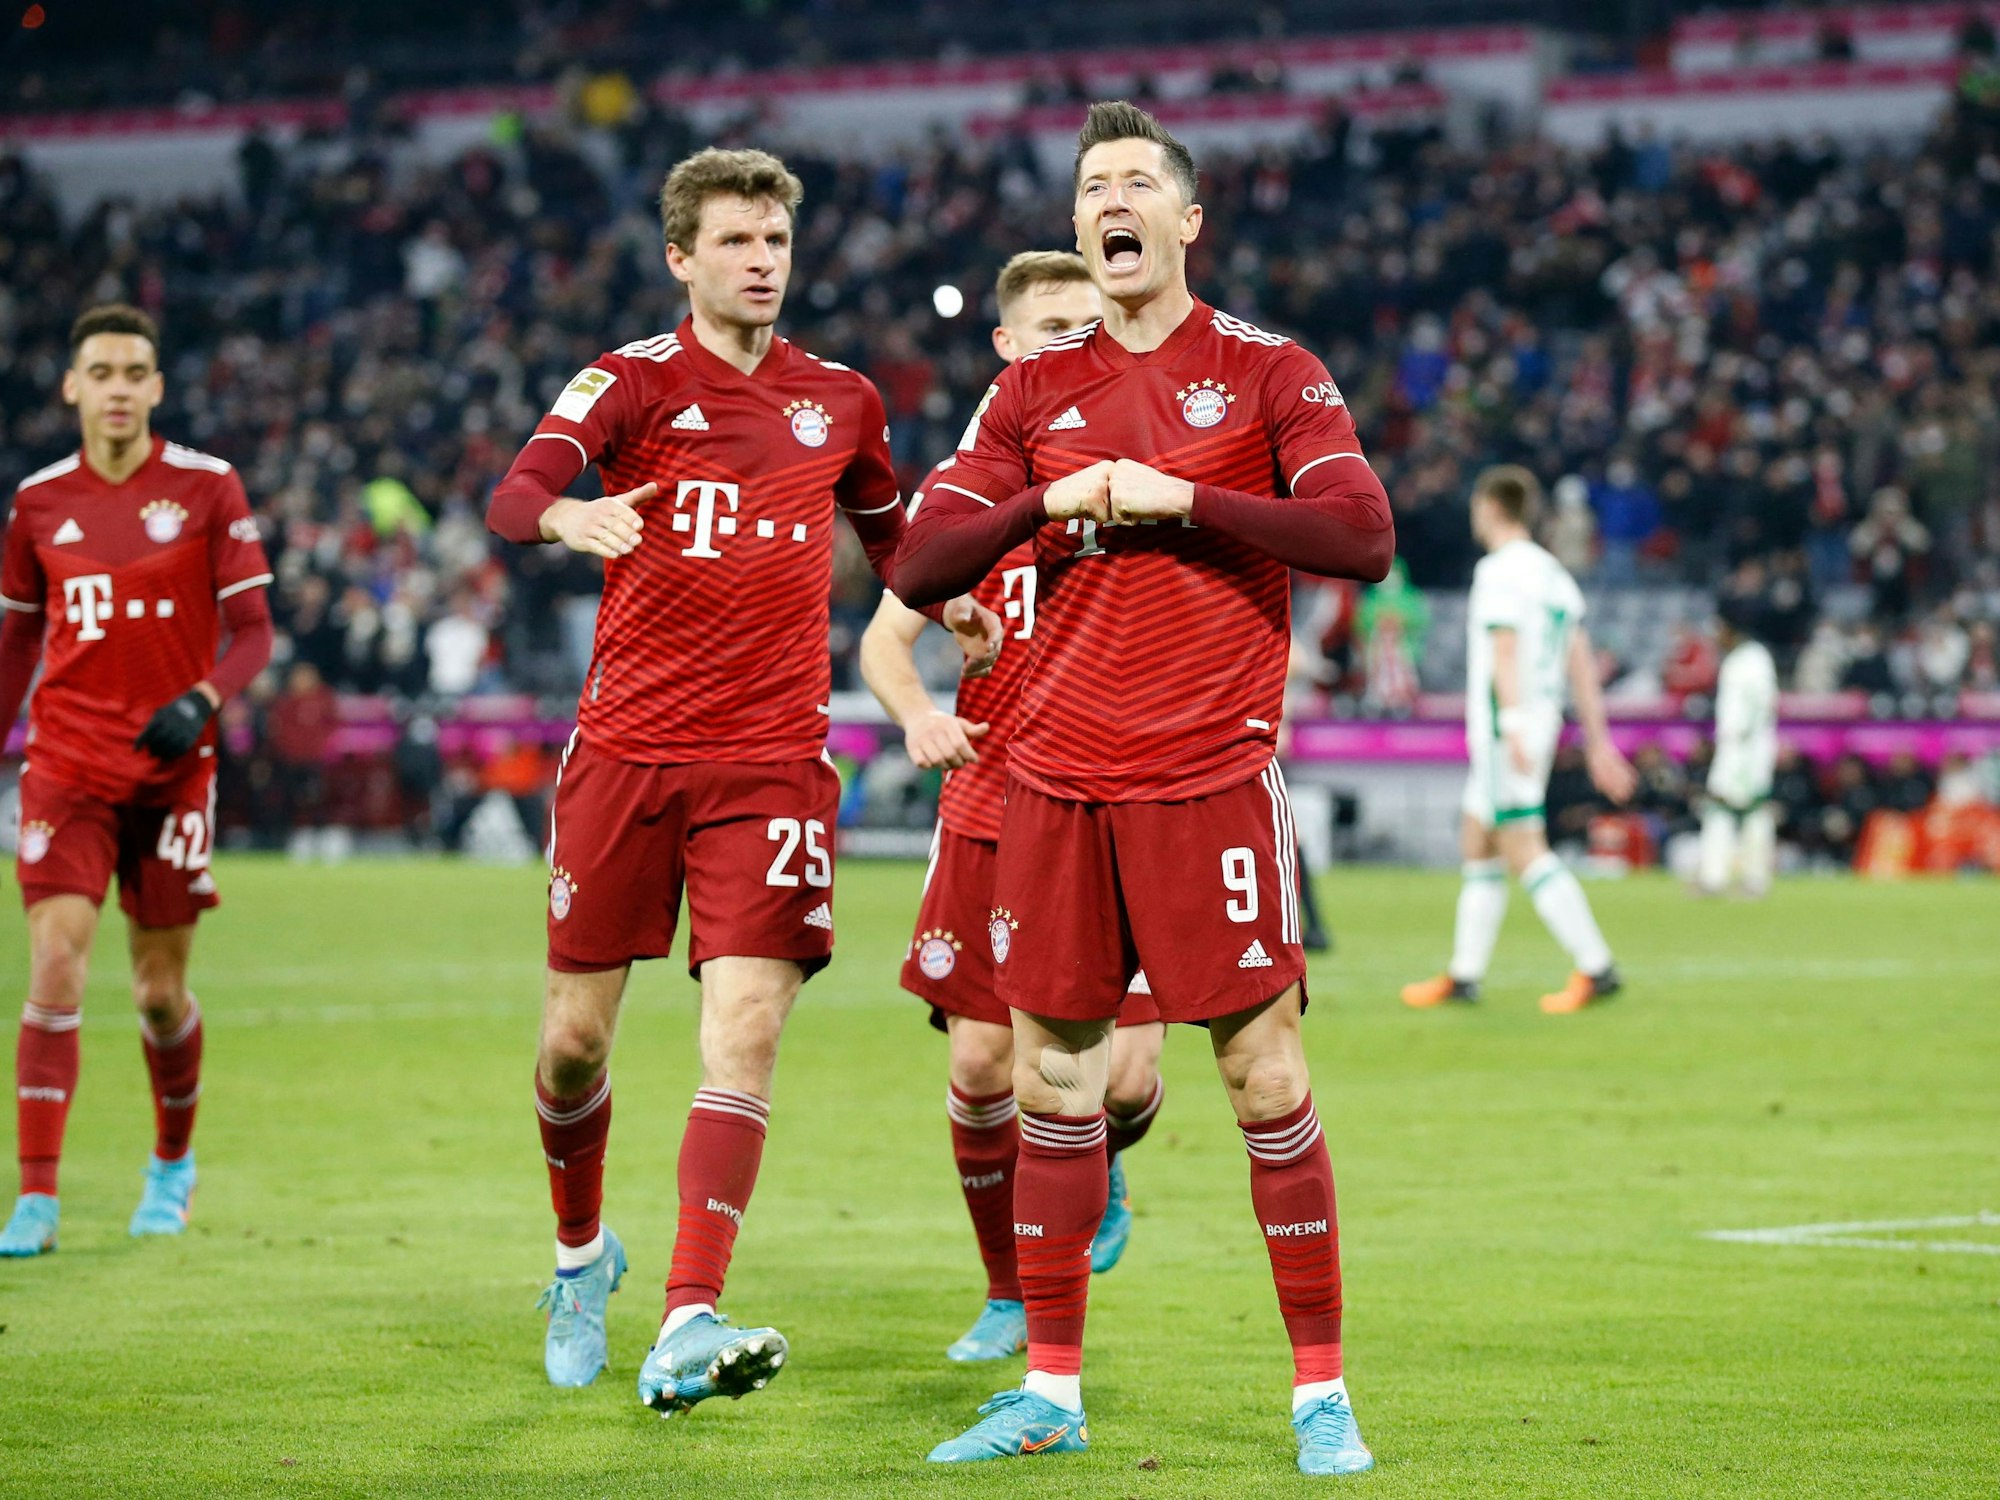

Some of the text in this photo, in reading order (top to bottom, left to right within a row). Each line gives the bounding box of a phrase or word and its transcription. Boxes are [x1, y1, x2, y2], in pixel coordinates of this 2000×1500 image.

[671, 419, 710, 431] adidas
[1048, 419, 1087, 431] adidas
[156, 811, 210, 871] 42
[766, 818, 832, 888] 25
[1221, 847, 1259, 923] 9
[1238, 957, 1273, 968] adidas
[1266, 1219, 1328, 1237] BAYERN
